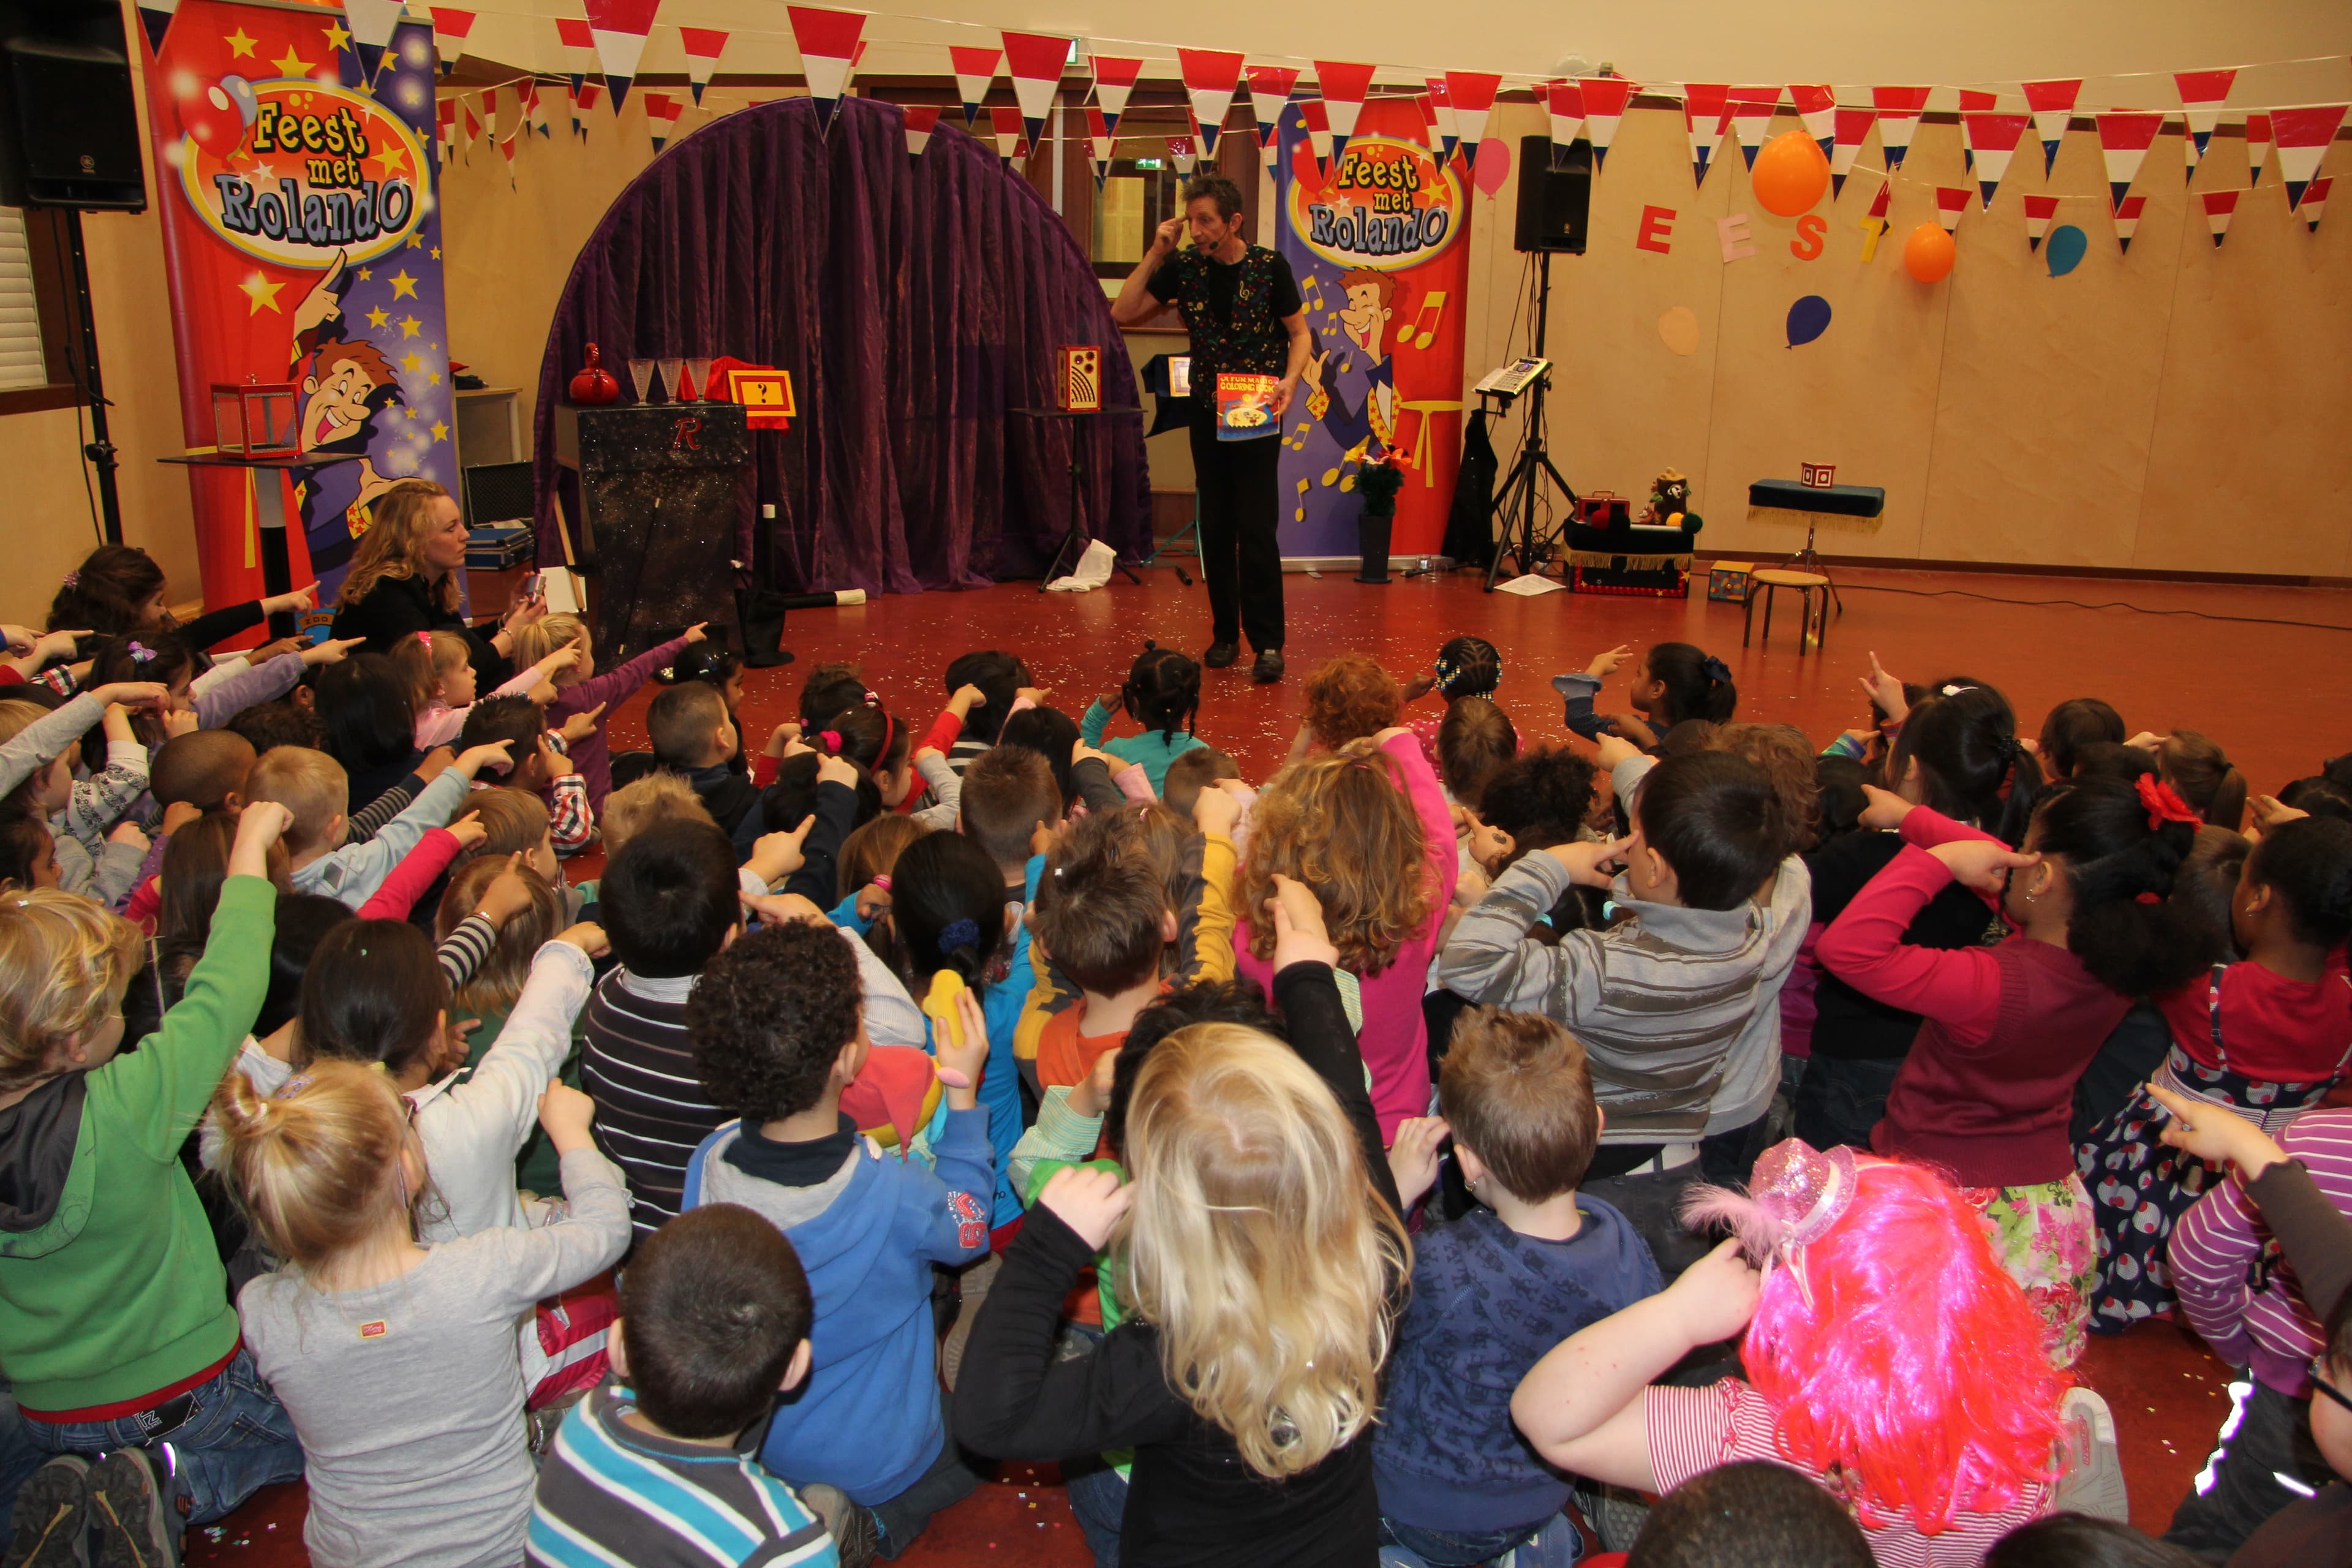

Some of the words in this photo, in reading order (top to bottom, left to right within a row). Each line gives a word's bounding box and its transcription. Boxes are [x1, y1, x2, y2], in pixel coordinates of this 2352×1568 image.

[252, 102, 368, 156] Feest
[306, 153, 360, 189] met
[1338, 153, 1420, 191] Feest
[1374, 188, 1412, 213] met
[1220, 382, 1255, 391] COLORING
[1256, 383, 1275, 393] BOOK
